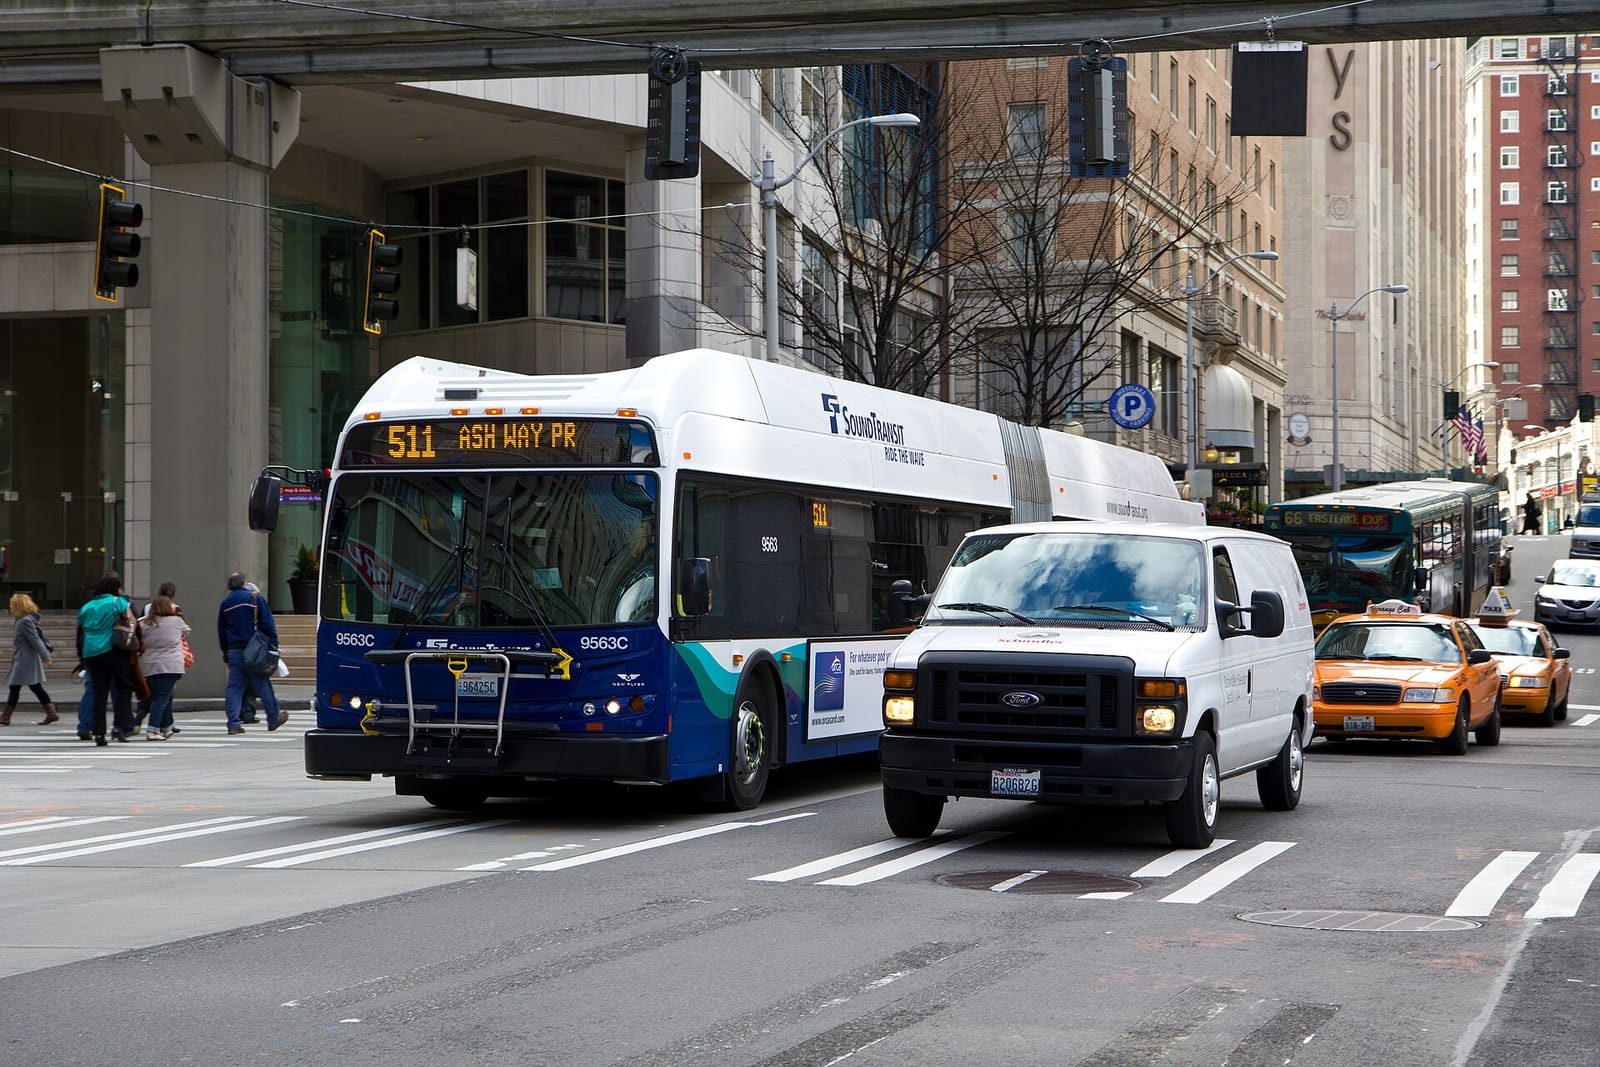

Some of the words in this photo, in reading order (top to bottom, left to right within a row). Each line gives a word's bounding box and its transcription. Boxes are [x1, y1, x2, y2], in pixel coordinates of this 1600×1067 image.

[1125, 395, 1142, 417] P
[388, 425, 436, 458] 511
[459, 424, 496, 449] ASH
[503, 423, 543, 448] WAY
[551, 422, 576, 448] PR
[884, 446, 898, 462] RIDE
[898, 448, 909, 464] THE
[909, 450, 925, 467] WAVE
[813, 503, 828, 527] 511
[1284, 511, 1303, 525] 66
[1308, 513, 1360, 525] EASTLAKE
[1362, 515, 1383, 525] EXP
[761, 536, 778, 552] 9563
[336, 632, 375, 647] 9563C
[580, 636, 628, 650] 9563C
[858, 650, 876, 662] whatever
[876, 650, 886, 664] pod
[463, 680, 496, 693] 96425C
[1009, 693, 1031, 704] Ford
[812, 714, 845, 726] www.orcacard.com
